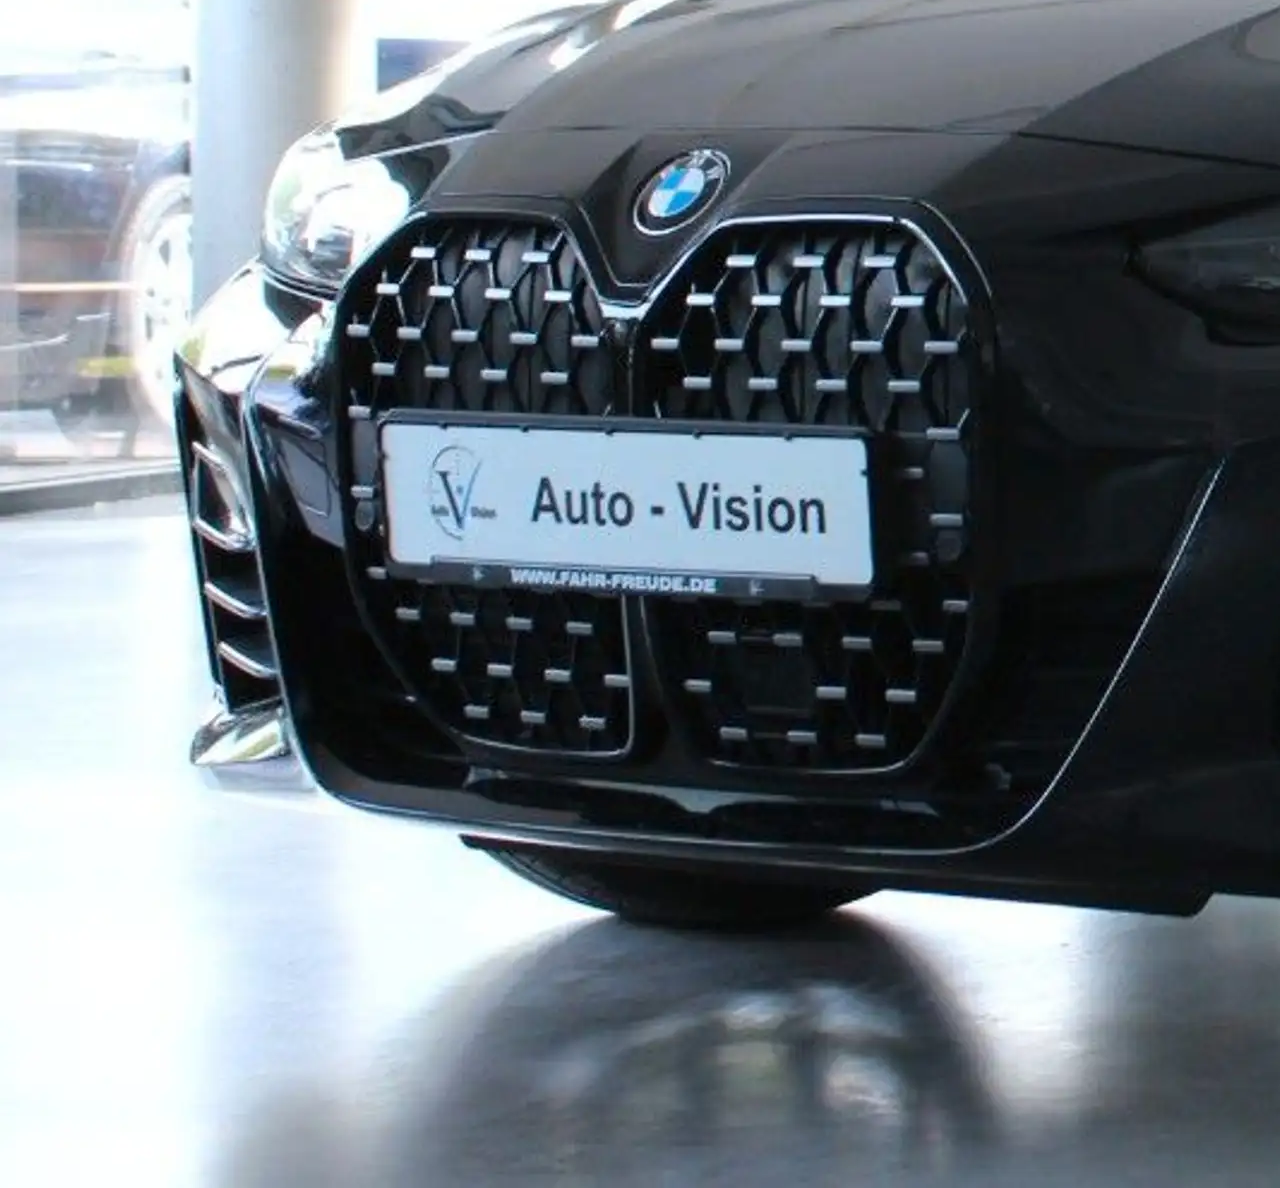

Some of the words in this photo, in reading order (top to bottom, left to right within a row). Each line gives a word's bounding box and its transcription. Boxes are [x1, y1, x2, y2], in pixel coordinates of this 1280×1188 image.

[531, 476, 635, 527] Auto
[677, 481, 827, 534] Vision
[511, 568, 717, 594] WWW.FAHR-FREUDE.DE
